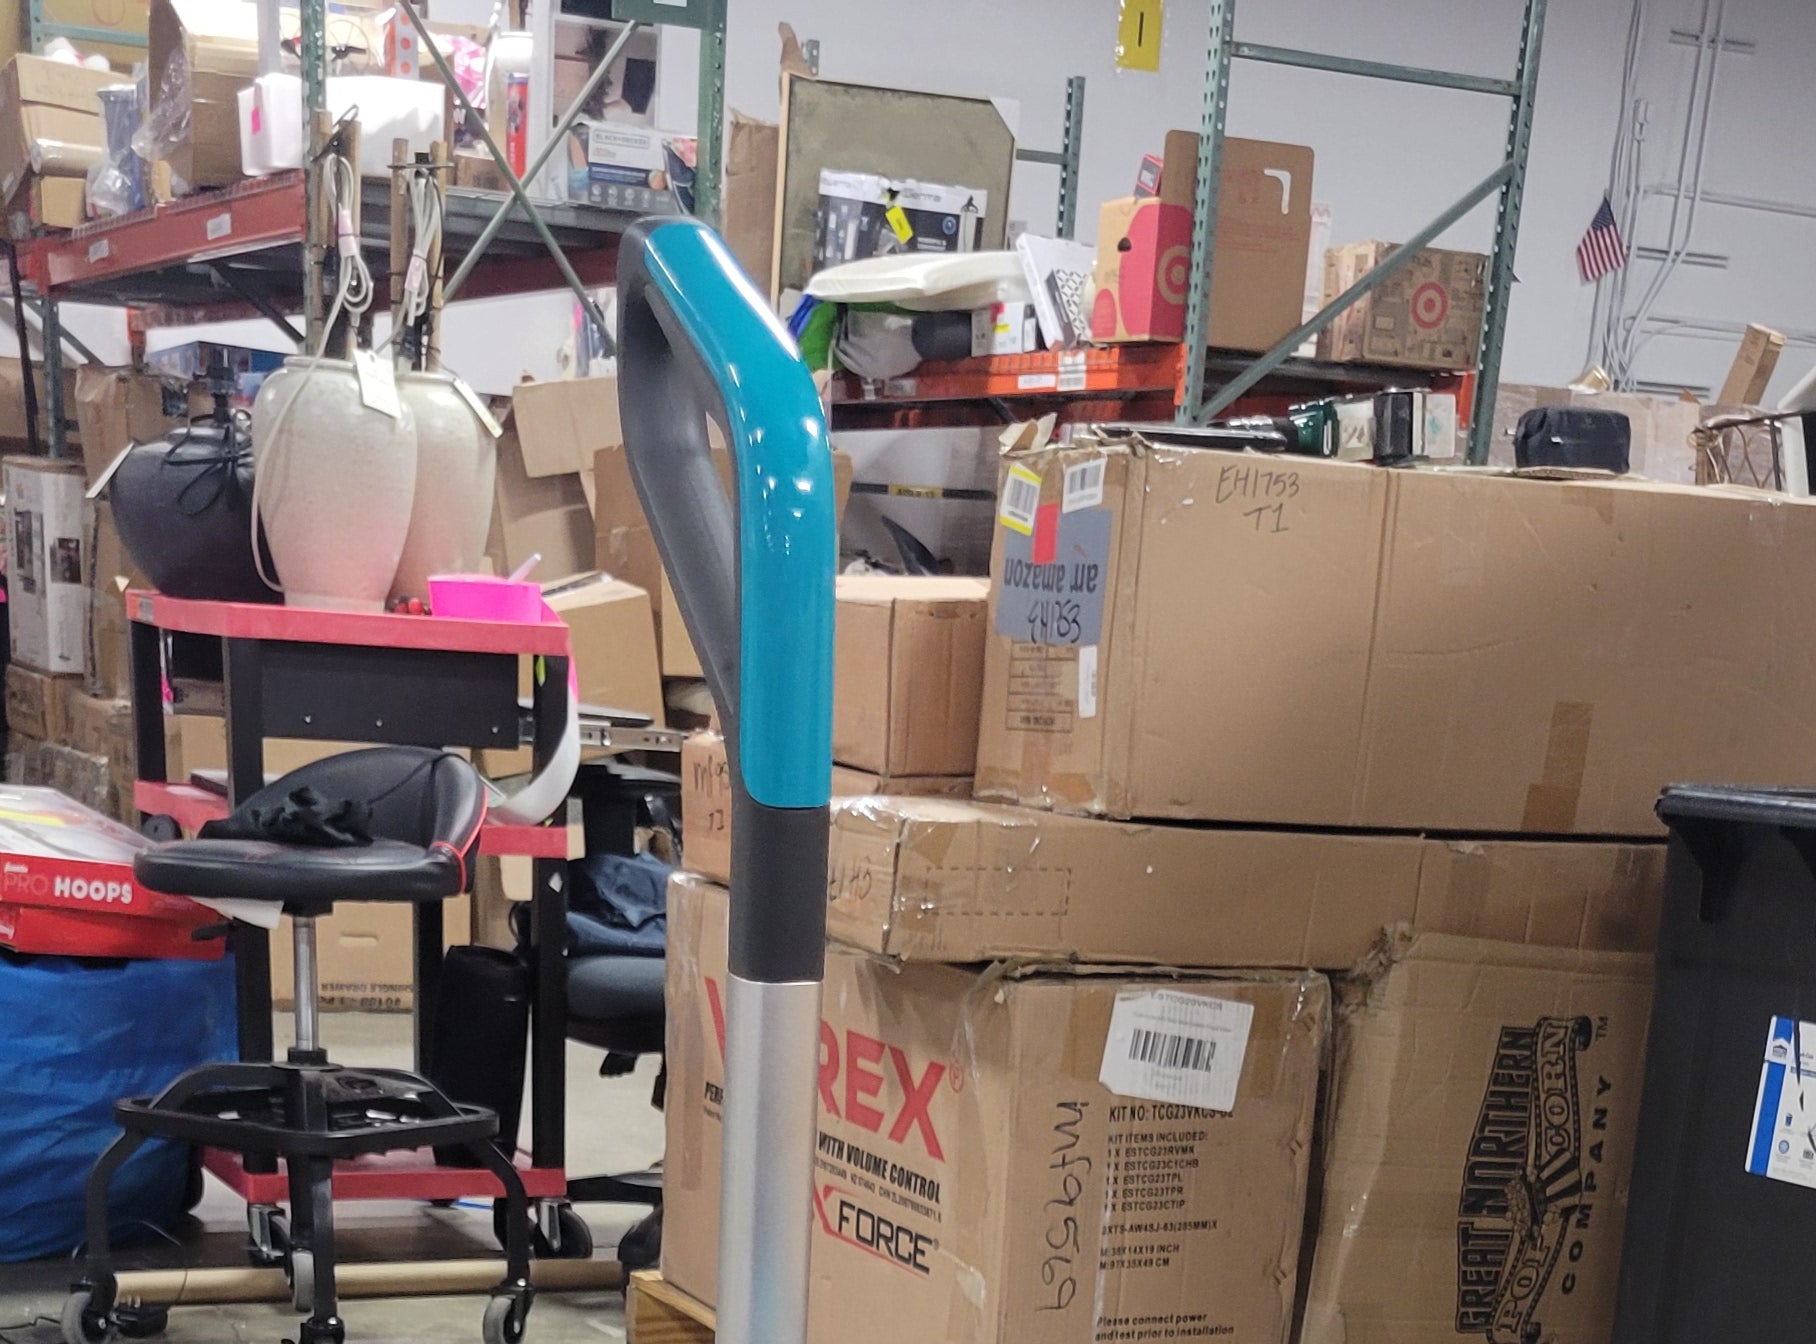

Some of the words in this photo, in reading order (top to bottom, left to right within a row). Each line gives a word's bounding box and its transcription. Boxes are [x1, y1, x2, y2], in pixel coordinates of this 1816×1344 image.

[1215, 464, 1300, 504] EH1753
[3, 873, 49, 897] PRO
[54, 875, 133, 904] HOOPS
[1108, 1107, 1128, 1123] KIT
[1129, 1104, 1150, 1122] NO:
[1458, 1026, 1535, 1218] NORTHERN
[1107, 1134, 1124, 1145] KIT
[1125, 1132, 1154, 1144] ITEMS
[1155, 1130, 1208, 1143] INCLUDED:
[818, 1131, 846, 1162] WITH
[846, 1143, 889, 1182] VOLUME
[888, 1163, 942, 1205] CONTROL
[1495, 1236, 1550, 1333] POP
[1535, 1021, 1571, 1158] CORN
[1560, 1073, 1612, 1296] COMPANY
[838, 1199, 933, 1275] FORCE
[1156, 1244, 1180, 1254] INCH
[1155, 1257, 1170, 1268] CM
[1455, 1221, 1513, 1334] GREAT
[1096, 1315, 1131, 1328] Please
[1132, 1313, 1174, 1326] connect
[1175, 1313, 1208, 1326] power
[1114, 1330, 1136, 1341] test
[1137, 1327, 1163, 1341] prior
[1164, 1327, 1175, 1338] to
[1176, 1325, 1235, 1338] installation
